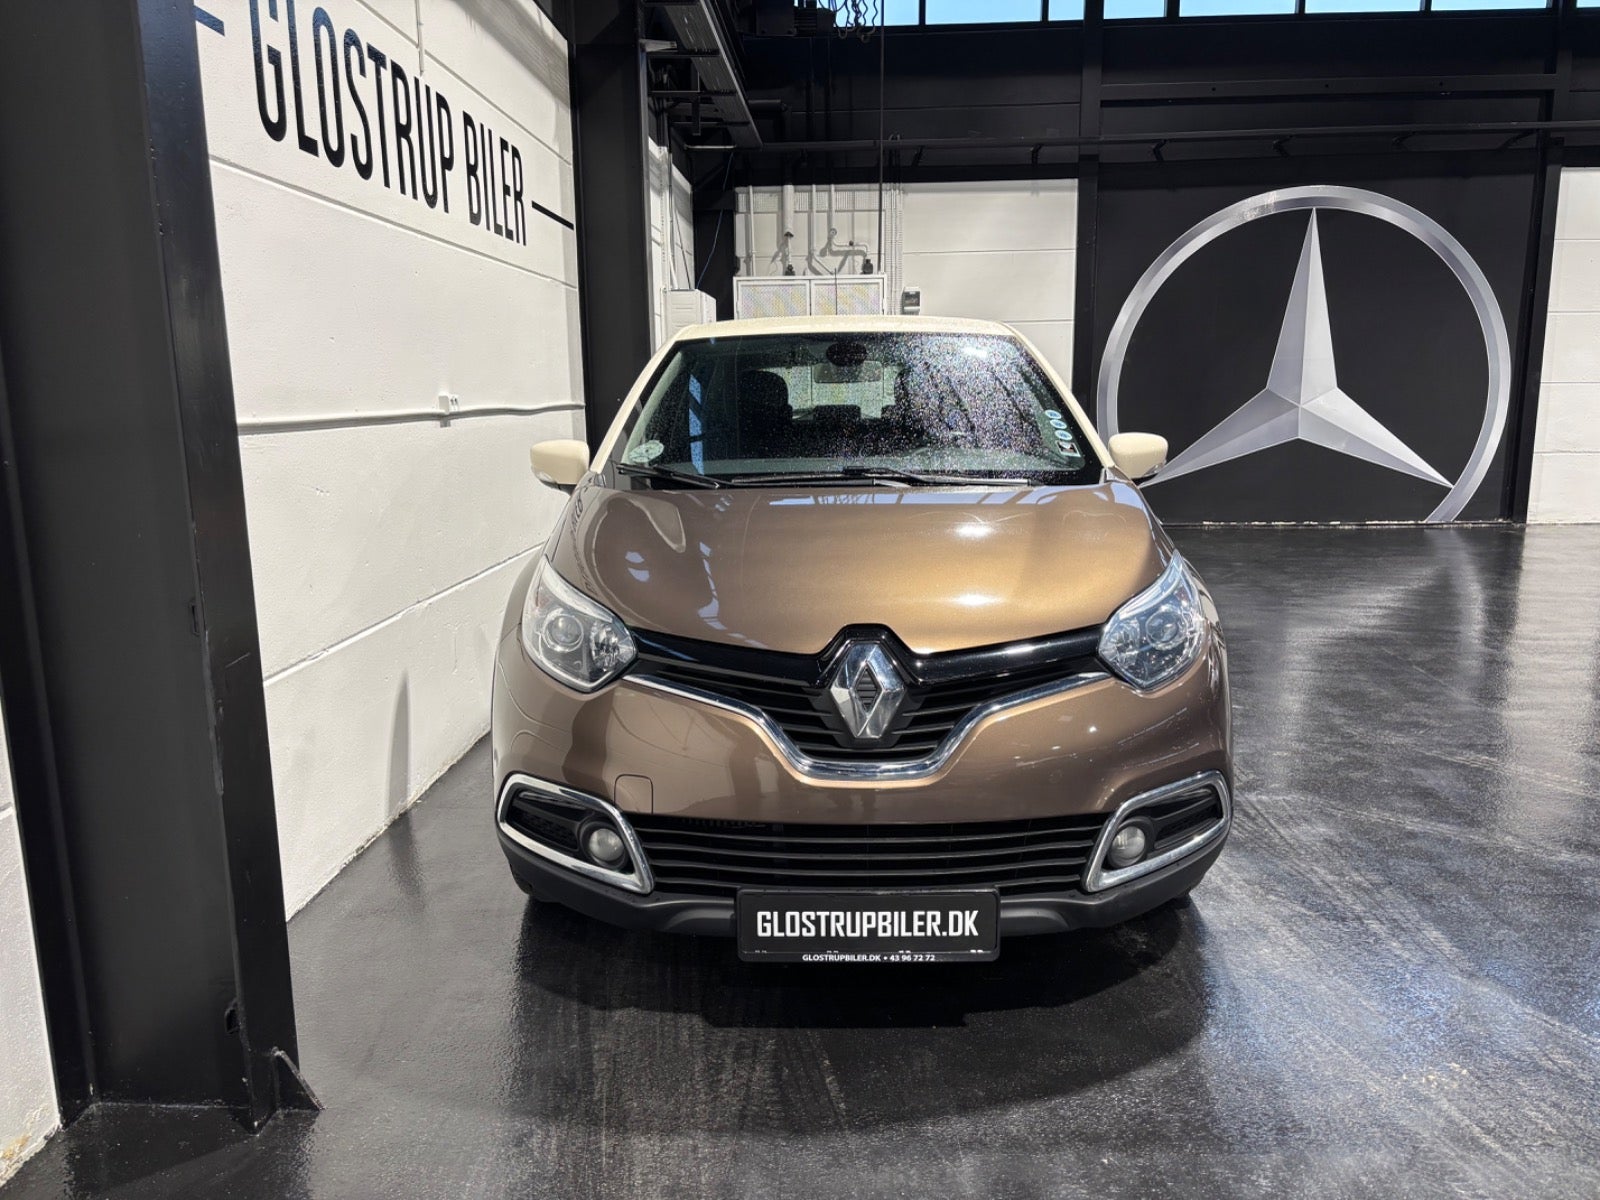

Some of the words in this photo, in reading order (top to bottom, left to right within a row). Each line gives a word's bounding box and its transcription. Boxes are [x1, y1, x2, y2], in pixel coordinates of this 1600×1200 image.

[249, 0, 454, 214] GLOSTRUP
[462, 110, 527, 246] BILER
[756, 910, 979, 938] GLOSTRUPBILER.DK
[802, 953, 881, 961] GLOSTRUPBILER.DK
